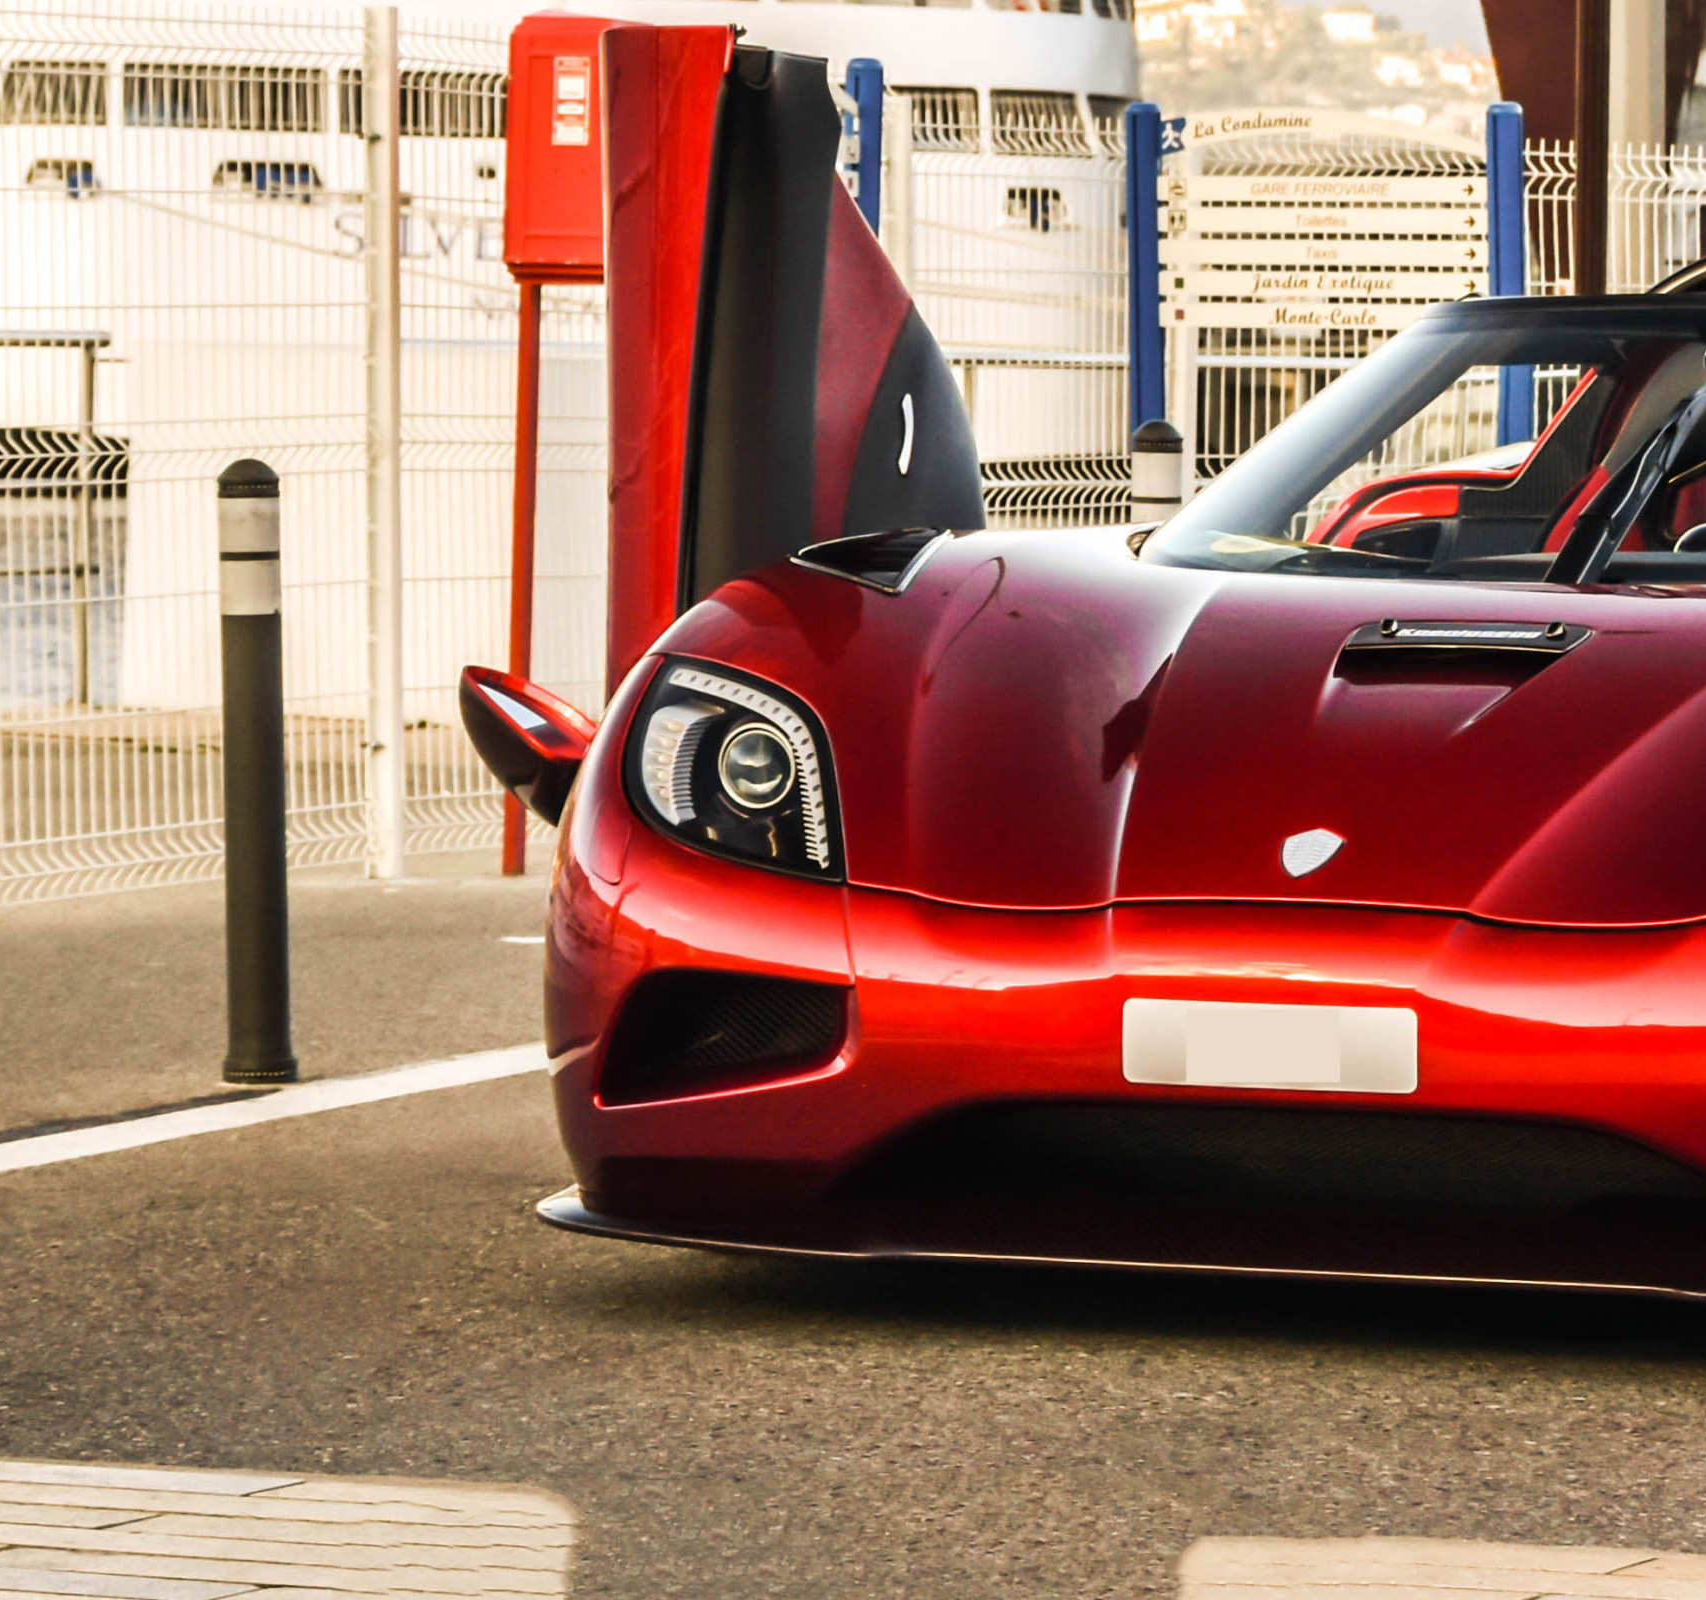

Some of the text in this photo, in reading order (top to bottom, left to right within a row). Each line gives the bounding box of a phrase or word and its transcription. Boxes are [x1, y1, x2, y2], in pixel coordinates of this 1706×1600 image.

[1194, 111, 1312, 139] La Condamine
[1250, 182, 1390, 197] GARE FERROVIAIRE
[1296, 213, 1347, 228] Toilettes
[1307, 246, 1339, 260] Taxis
[1253, 273, 1394, 295] Jardin Exotique
[1271, 306, 1377, 326] Monte-Carlo
